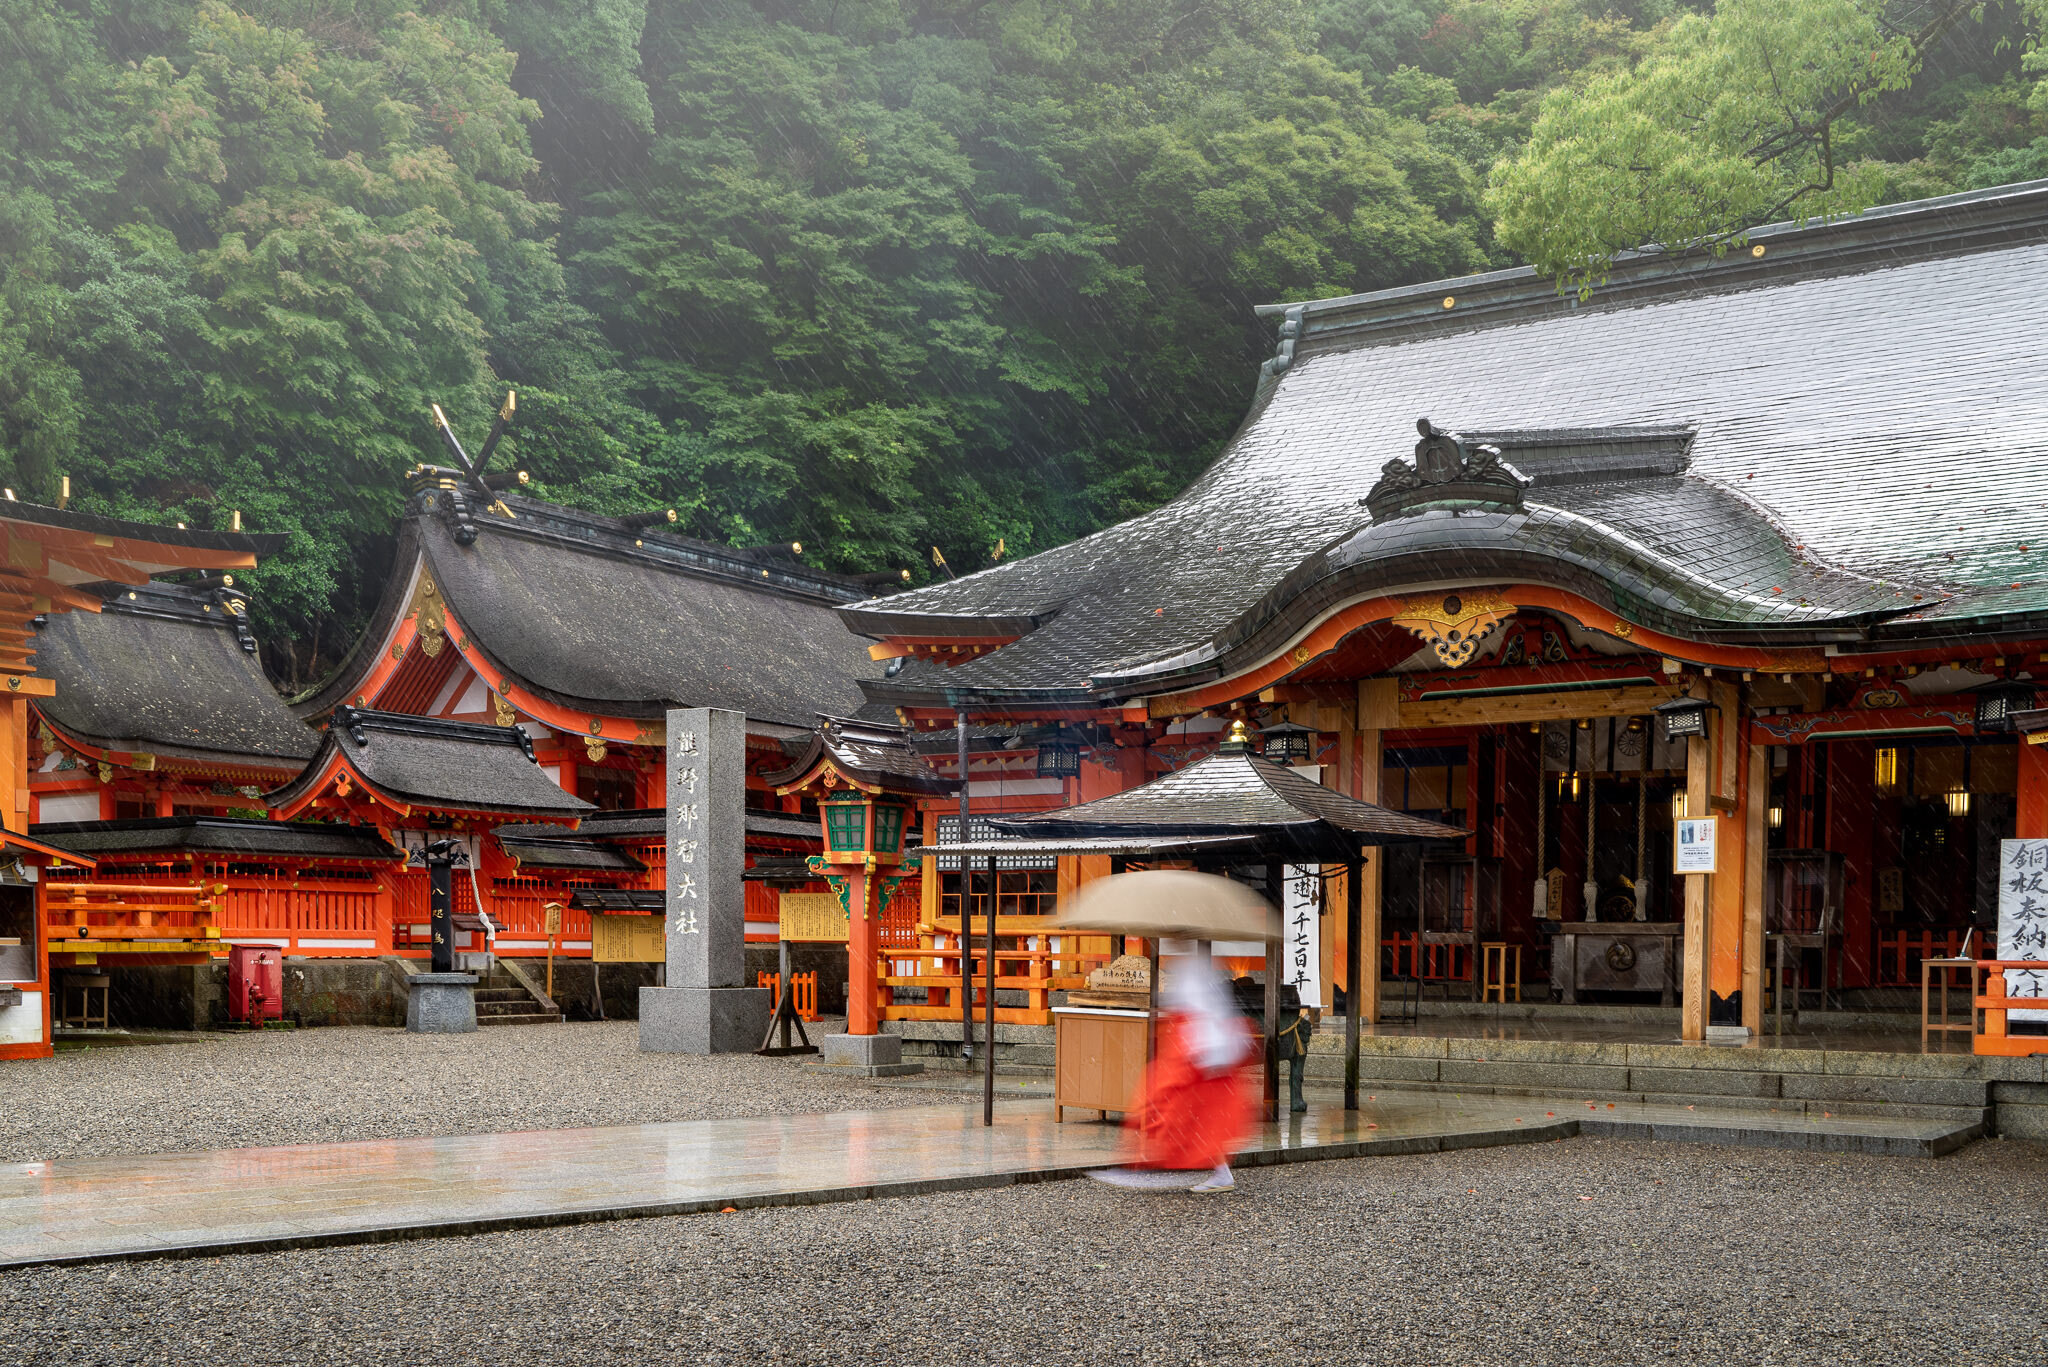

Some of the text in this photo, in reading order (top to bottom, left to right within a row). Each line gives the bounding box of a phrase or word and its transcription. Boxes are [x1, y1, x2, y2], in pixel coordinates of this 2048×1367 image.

[676, 730, 699, 935] 熊野那智大社
